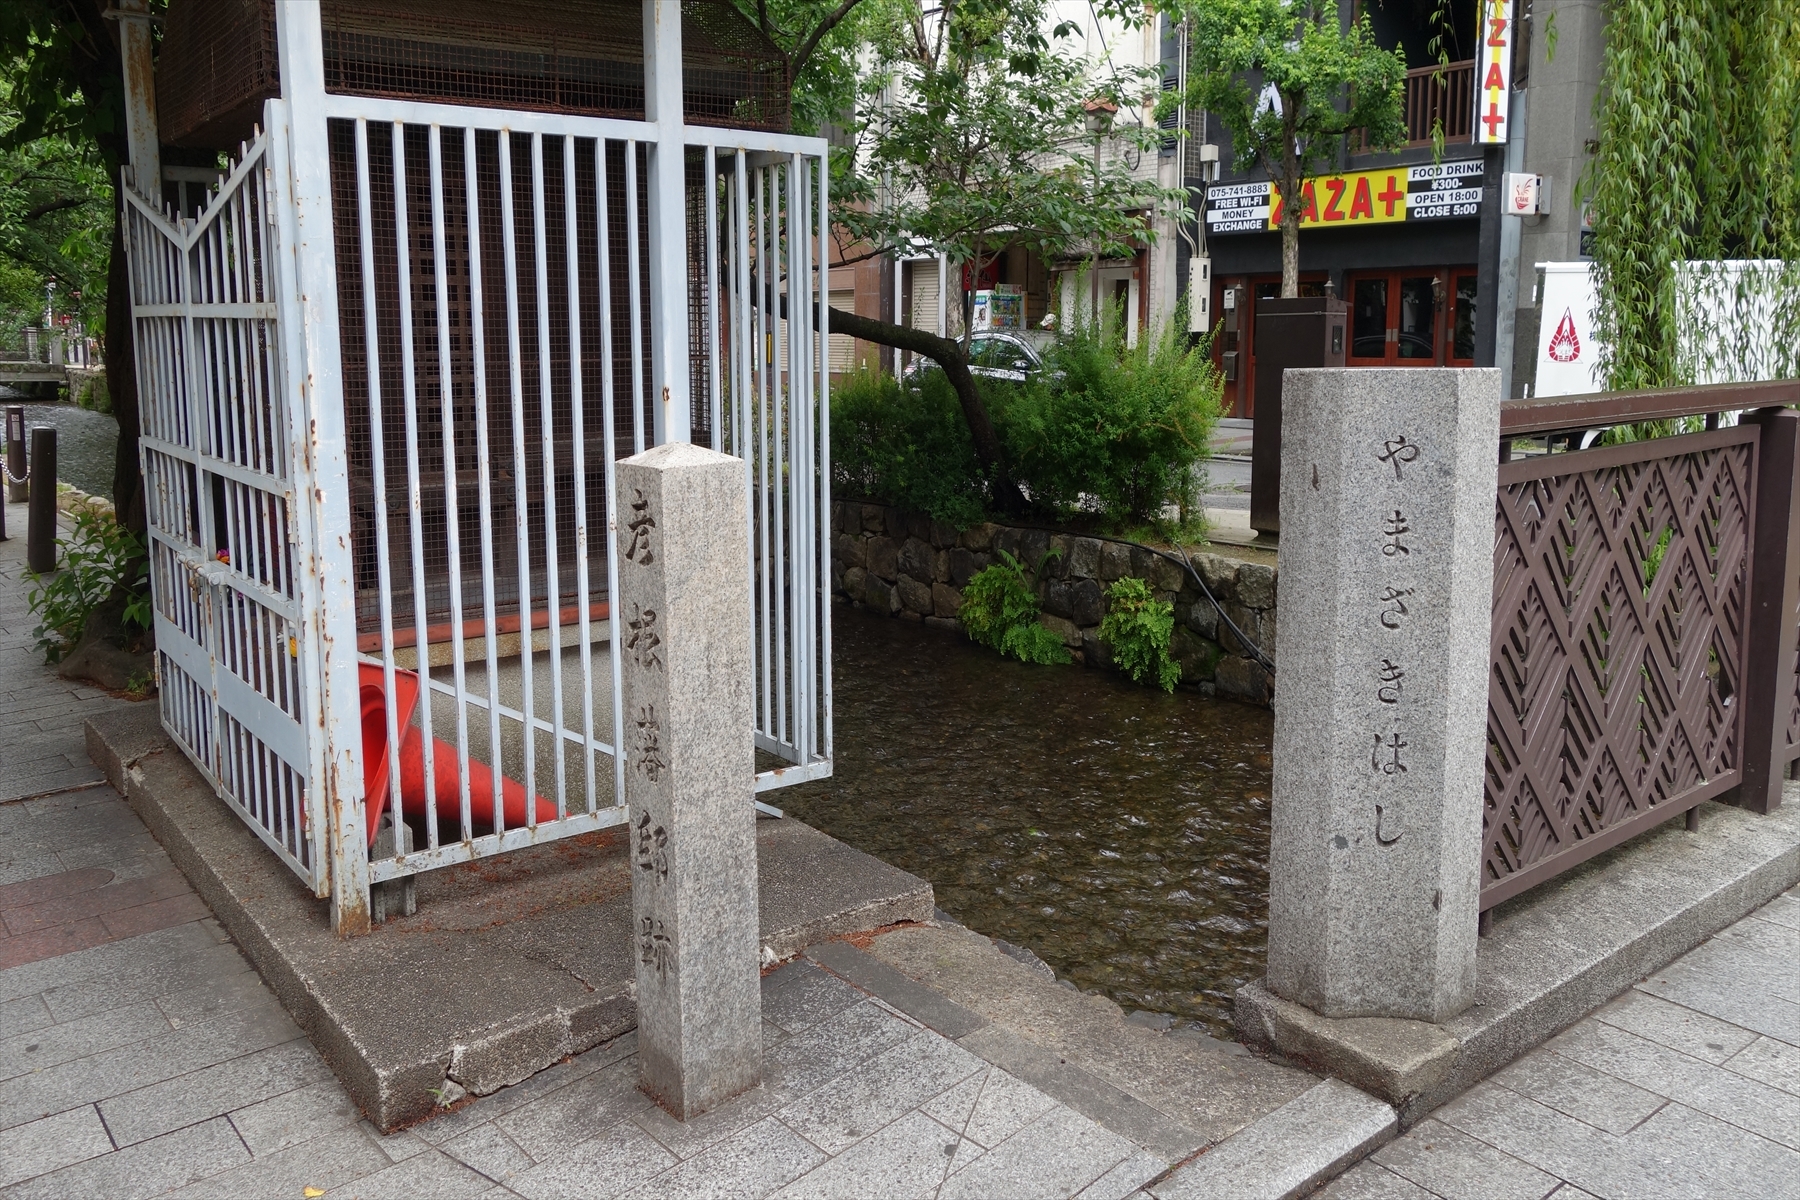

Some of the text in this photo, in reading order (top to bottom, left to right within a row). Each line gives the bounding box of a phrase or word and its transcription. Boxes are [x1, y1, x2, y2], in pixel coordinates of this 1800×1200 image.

[1482, 0, 1508, 136] ZA+
[1412, 163, 1483, 178] FOOD DRINK
[1211, 184, 1268, 197] 075-741-8883
[1415, 190, 1478, 204] OPEN 18:00
[1215, 196, 1262, 209] FREE WI-FI
[1221, 209, 1254, 220] MONEY
[1414, 203, 1477, 218] CLOSE 5:00
[1213, 220, 1262, 232] EXCHANGE
[1371, 434, 1421, 848] やまざきはし
[625, 488, 675, 982] 彦根藩邸跡
